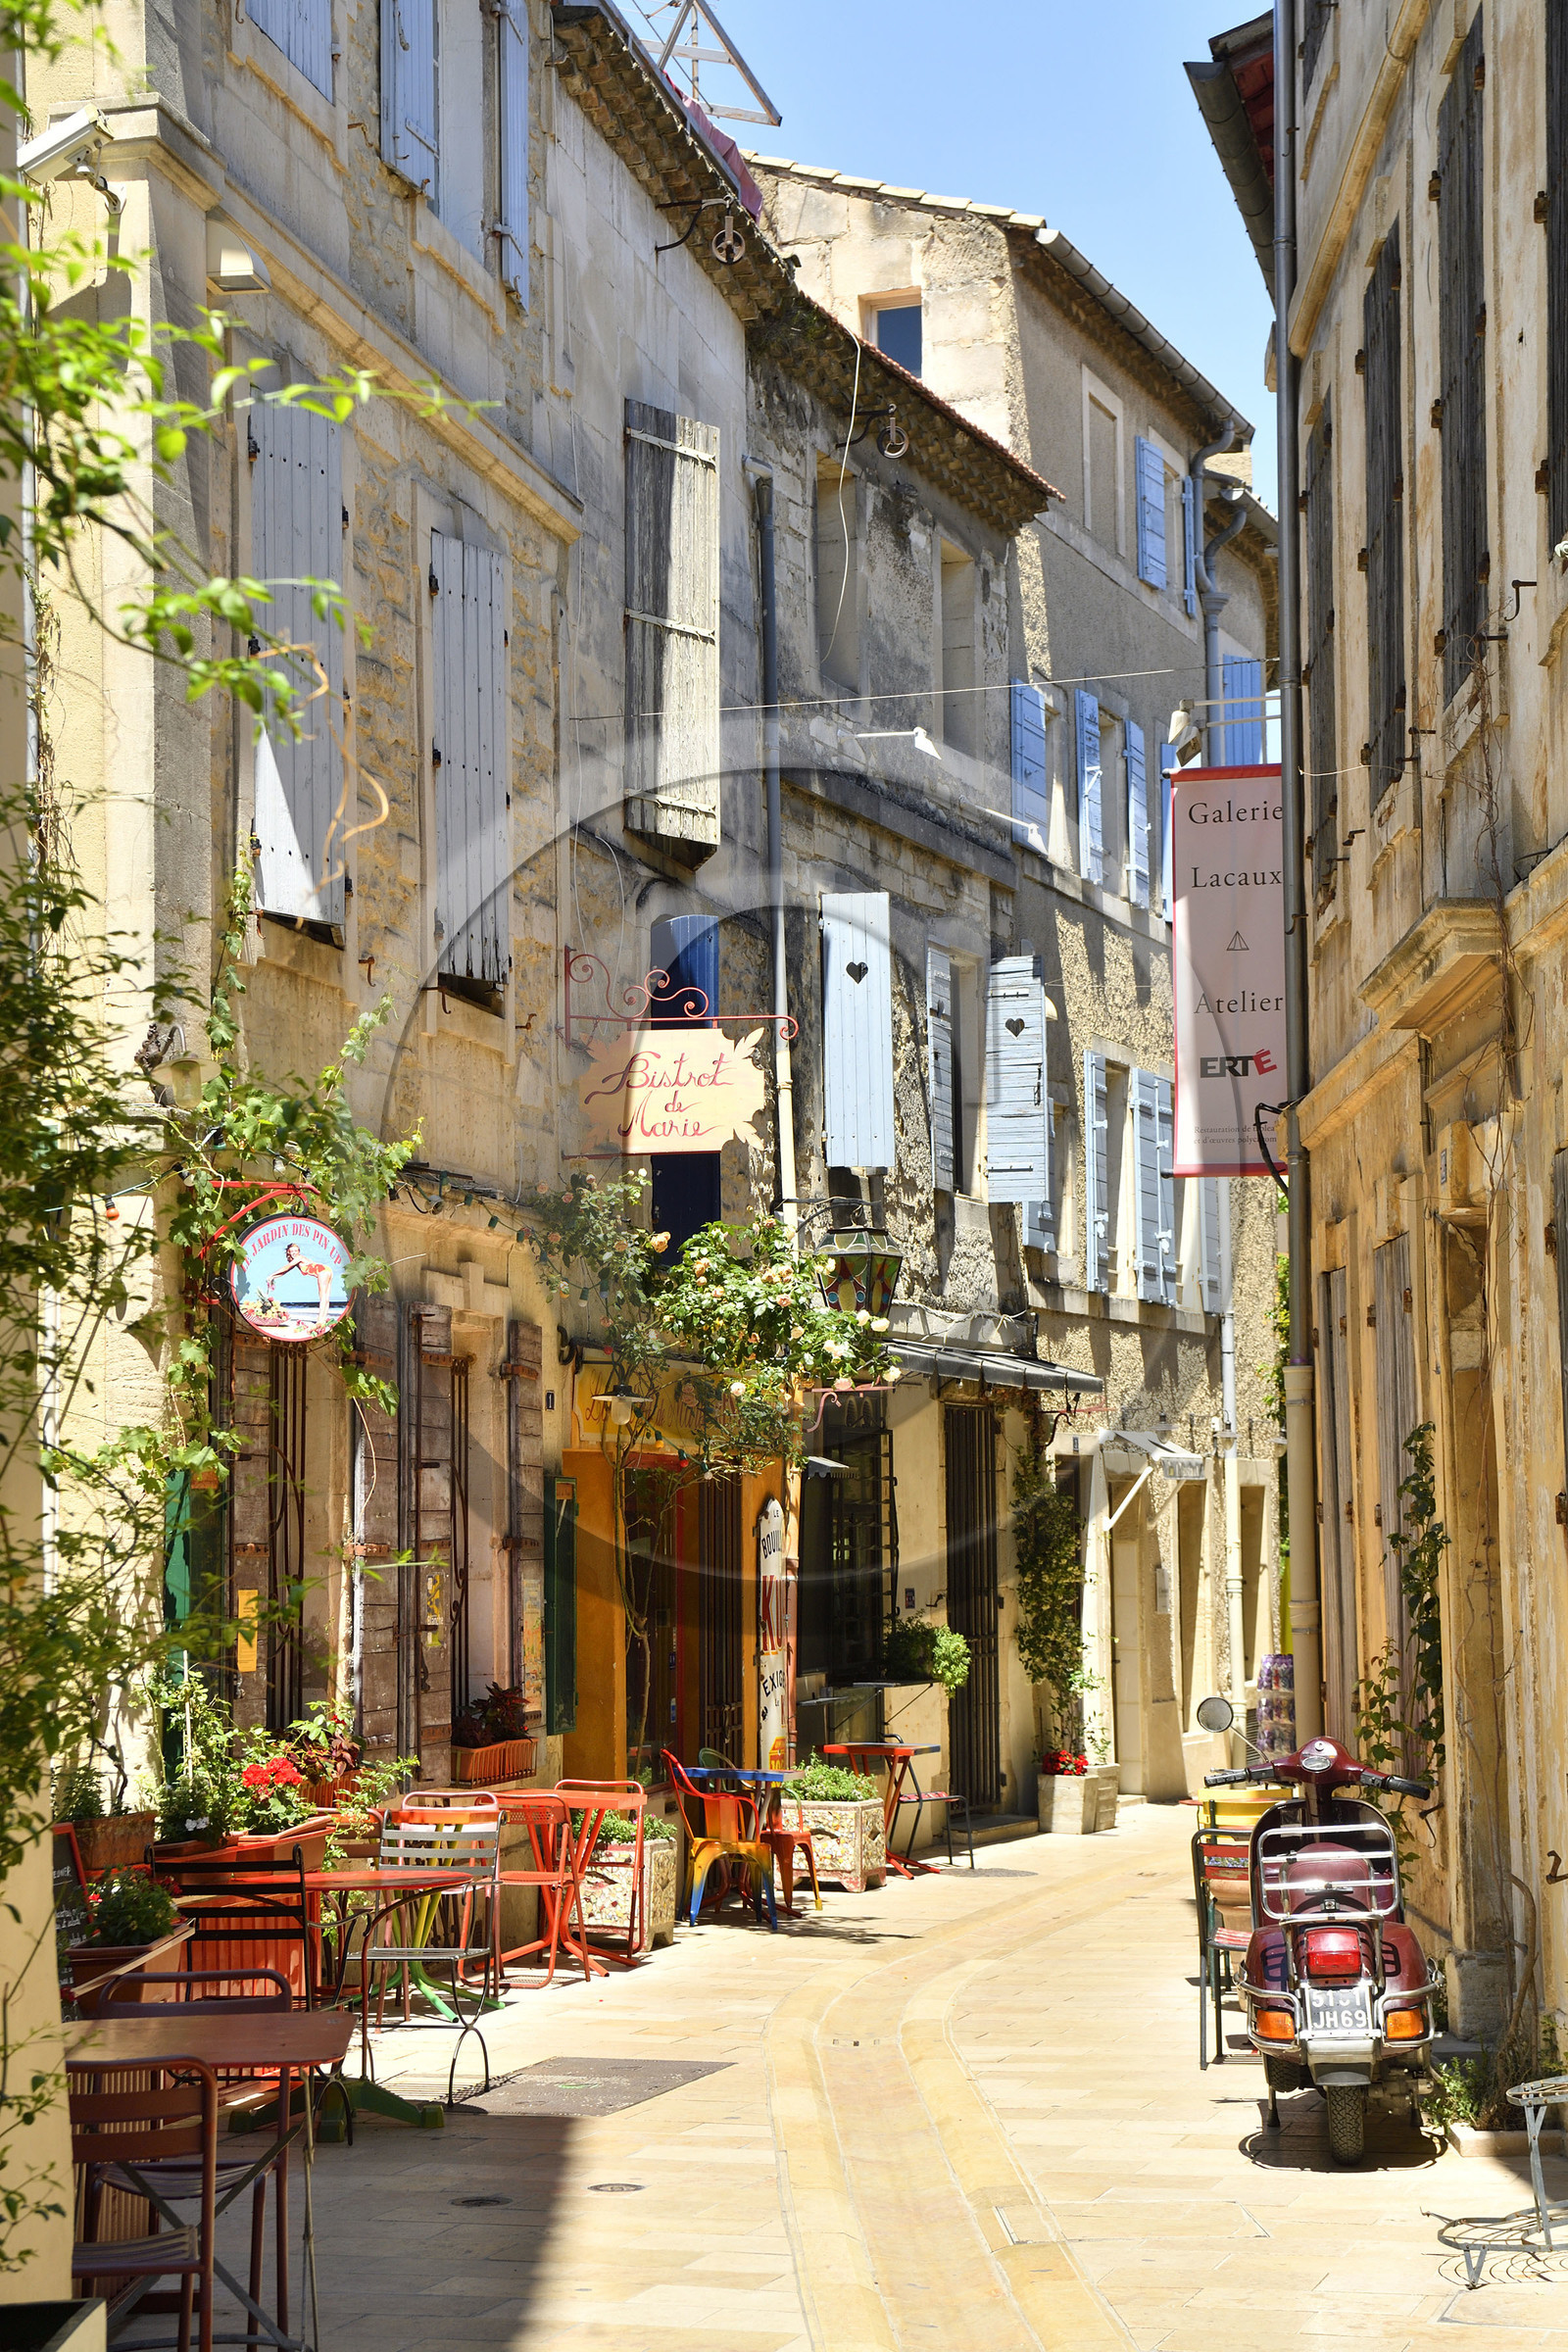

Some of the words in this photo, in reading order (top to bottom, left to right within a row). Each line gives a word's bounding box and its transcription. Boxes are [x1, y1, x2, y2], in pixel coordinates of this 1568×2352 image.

[1189, 800, 1283, 824] Galerie
[1192, 866, 1282, 888] Lacaux
[1194, 990, 1284, 1013] Atelier
[1200, 1049, 1278, 1079] ERTÉ
[584, 1051, 737, 1104] Bistrot
[664, 1090, 702, 1113] de
[617, 1090, 724, 1137] Marie
[1194, 1125, 1240, 1134] Restauration
[1242, 1124, 1251, 1133] de
[252, 1223, 289, 1256] JARDIN
[292, 1223, 311, 1237] DES
[313, 1230, 330, 1250] PIN
[329, 1246, 342, 1264] UP
[1312, 2009, 1367, 2030] JH69
